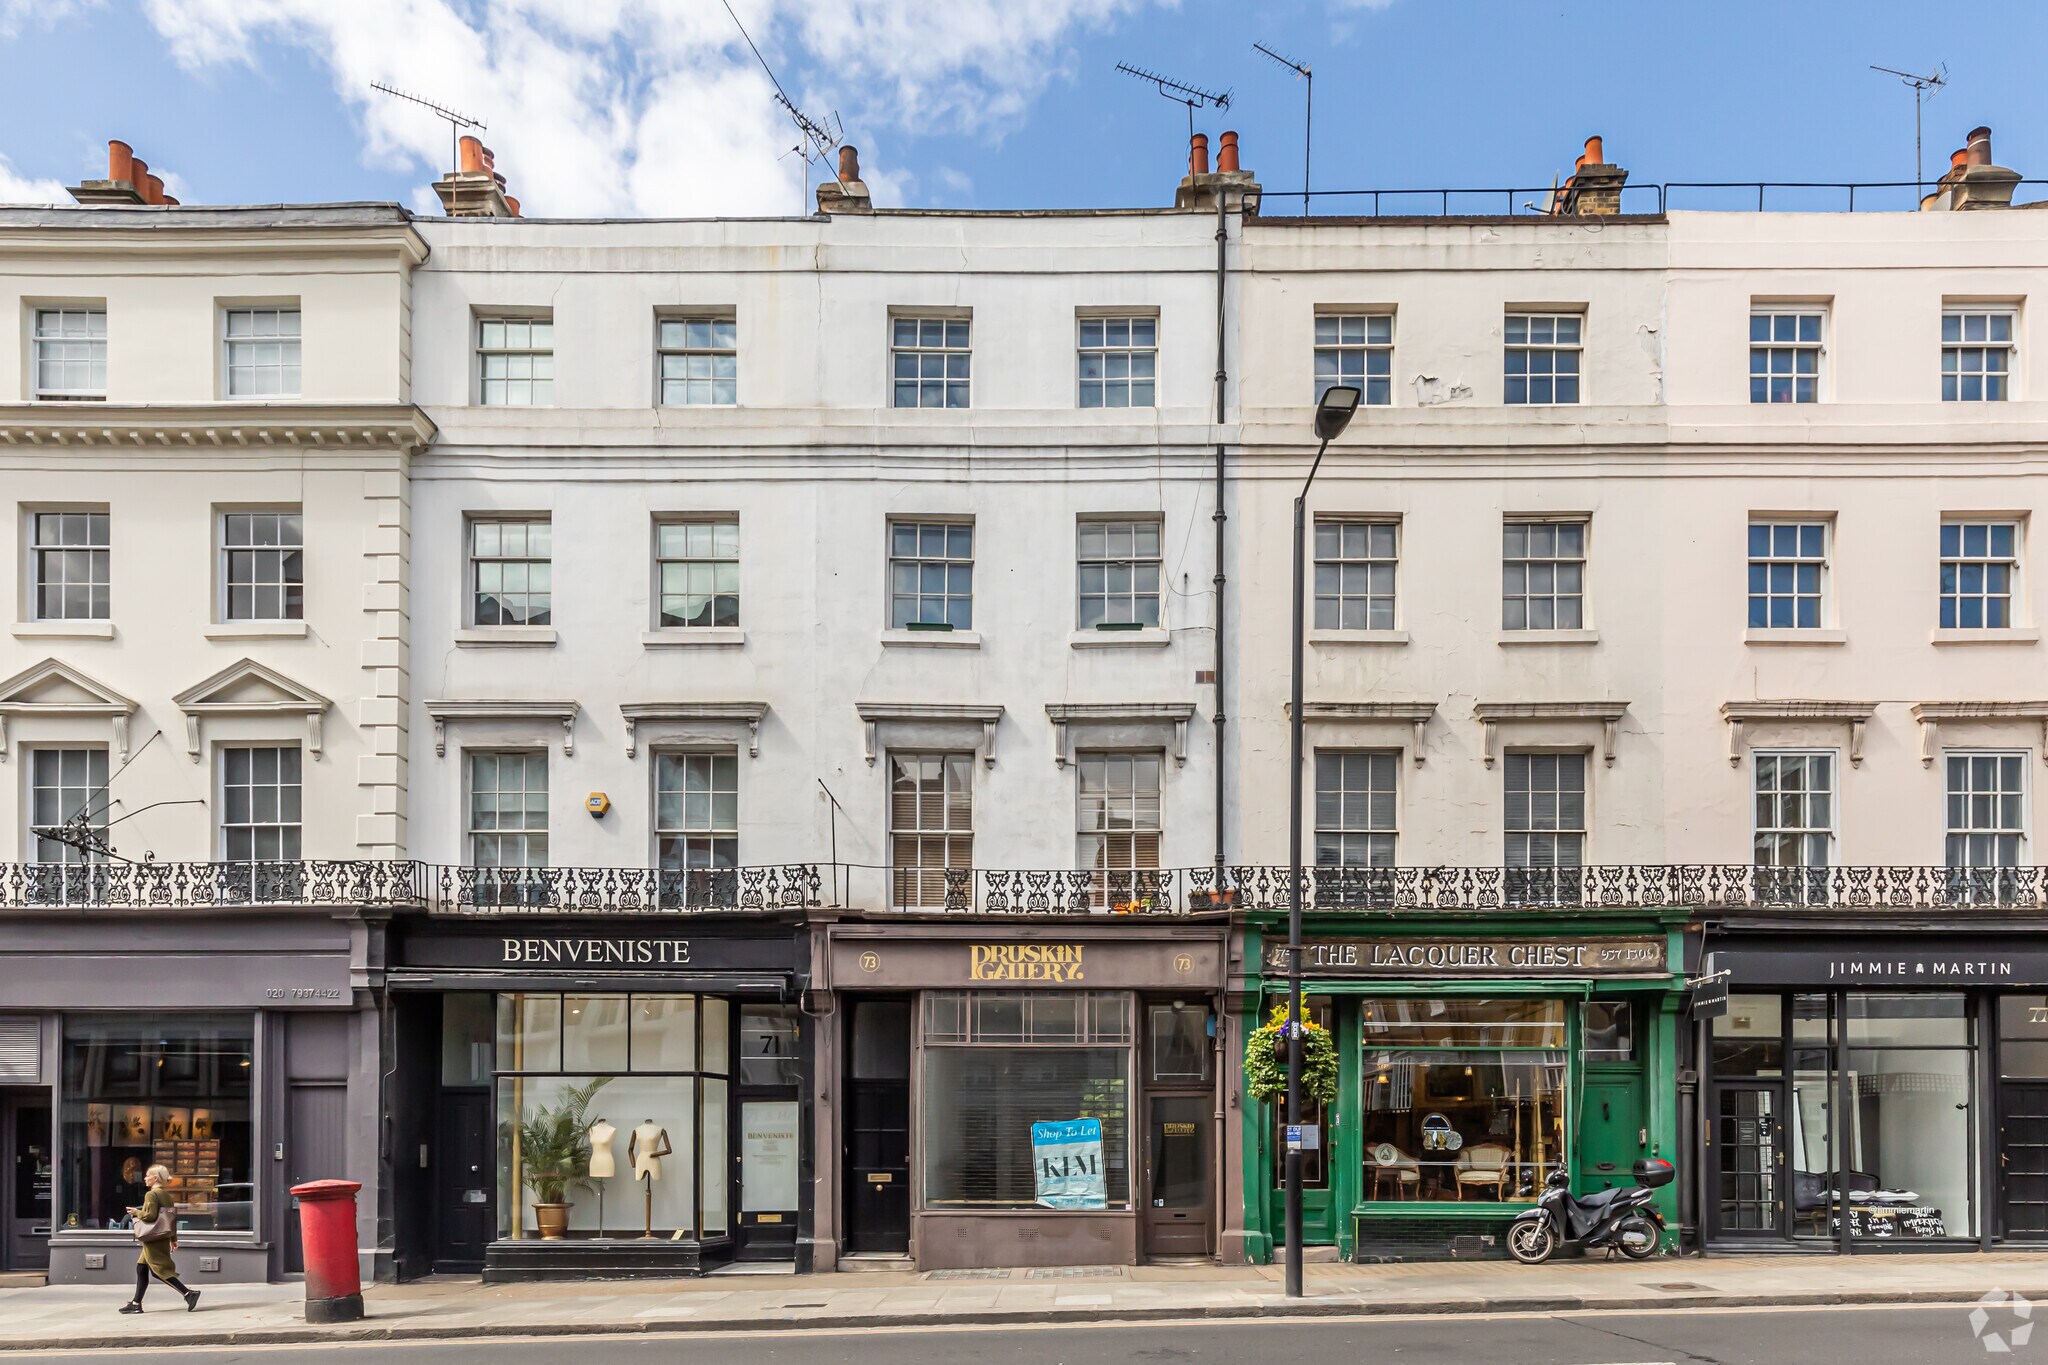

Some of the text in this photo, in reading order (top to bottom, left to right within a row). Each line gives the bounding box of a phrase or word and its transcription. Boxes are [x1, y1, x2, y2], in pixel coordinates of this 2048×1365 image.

[502, 939, 691, 963] BENVENISTE
[1310, 944, 1587, 968] THE LACQUER CHEST
[863, 956, 876, 968] 73
[1178, 958, 1191, 970] 73
[1829, 962, 2011, 979] JIMMIE MARTIN
[265, 988, 339, 999] 020 79374422
[760, 1035, 779, 1054] 71
[1037, 1125, 1097, 1141] Shop To Let
[1868, 1205, 1935, 1215] @jimmiemartin
